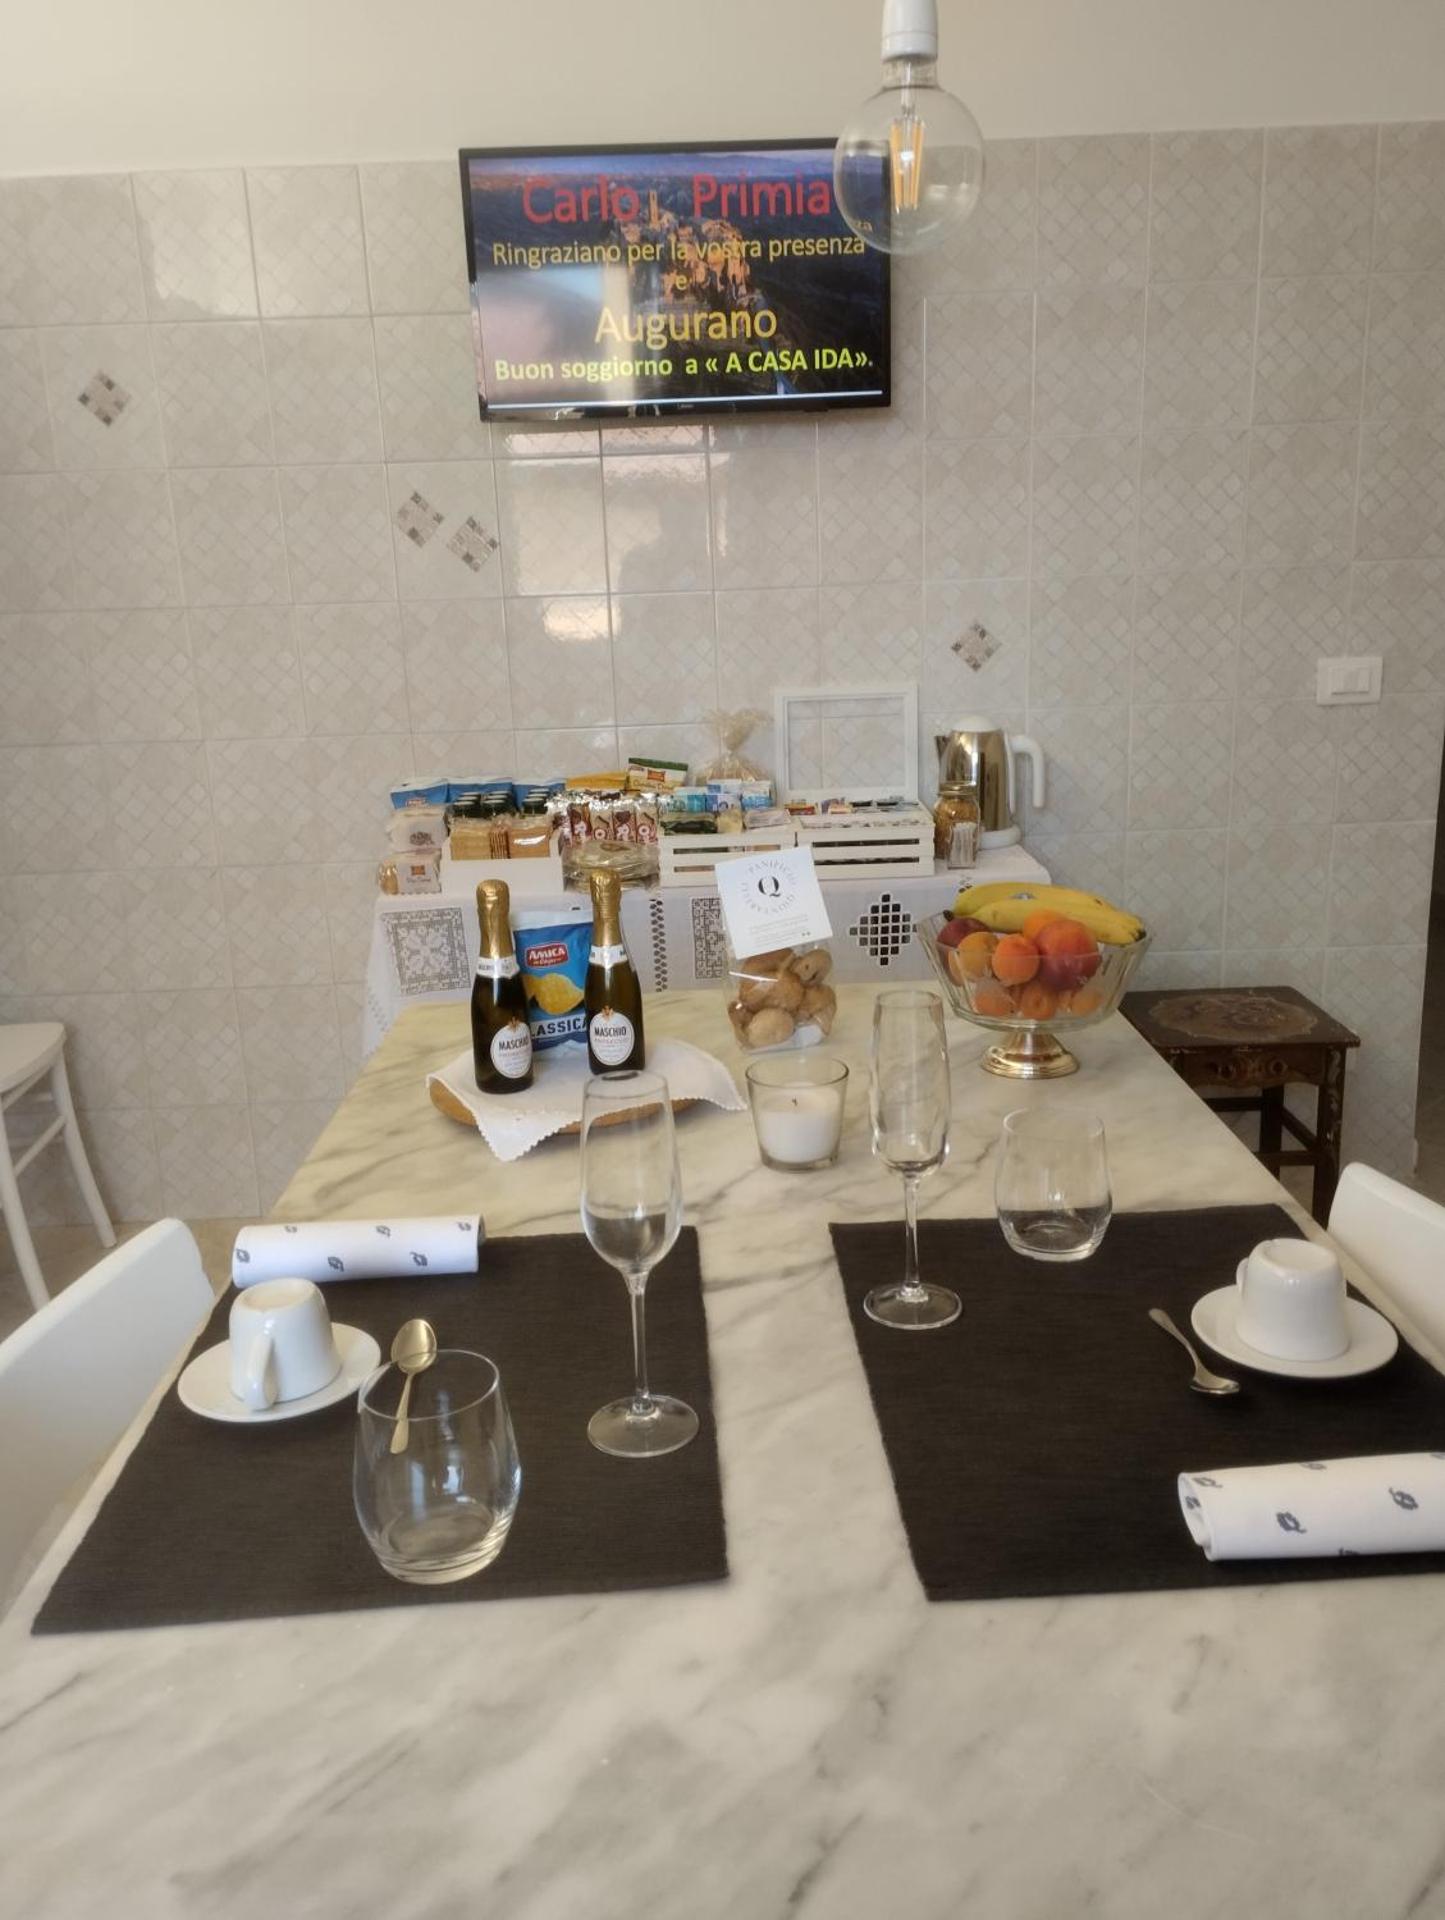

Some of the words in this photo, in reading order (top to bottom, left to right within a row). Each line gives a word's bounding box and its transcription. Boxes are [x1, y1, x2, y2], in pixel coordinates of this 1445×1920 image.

[523, 174, 640, 224] Carlo
[693, 169, 831, 218] Primia
[493, 242, 621, 271] Ringraziano
[628, 243, 663, 271] per
[671, 238, 687, 261] la
[696, 238, 761, 260] vostra
[769, 236, 866, 266] presenza
[675, 274, 688, 291] e
[595, 308, 778, 350] Augurano
[495, 359, 554, 381] Buon
[561, 357, 672, 386] soggiorno
[685, 360, 698, 376] a
[726, 351, 742, 372] A
[749, 349, 806, 373] CASA
[758, 876, 781, 898] Q
[529, 946, 566, 960] AMICA
[531, 1017, 588, 1038] ASSIC
